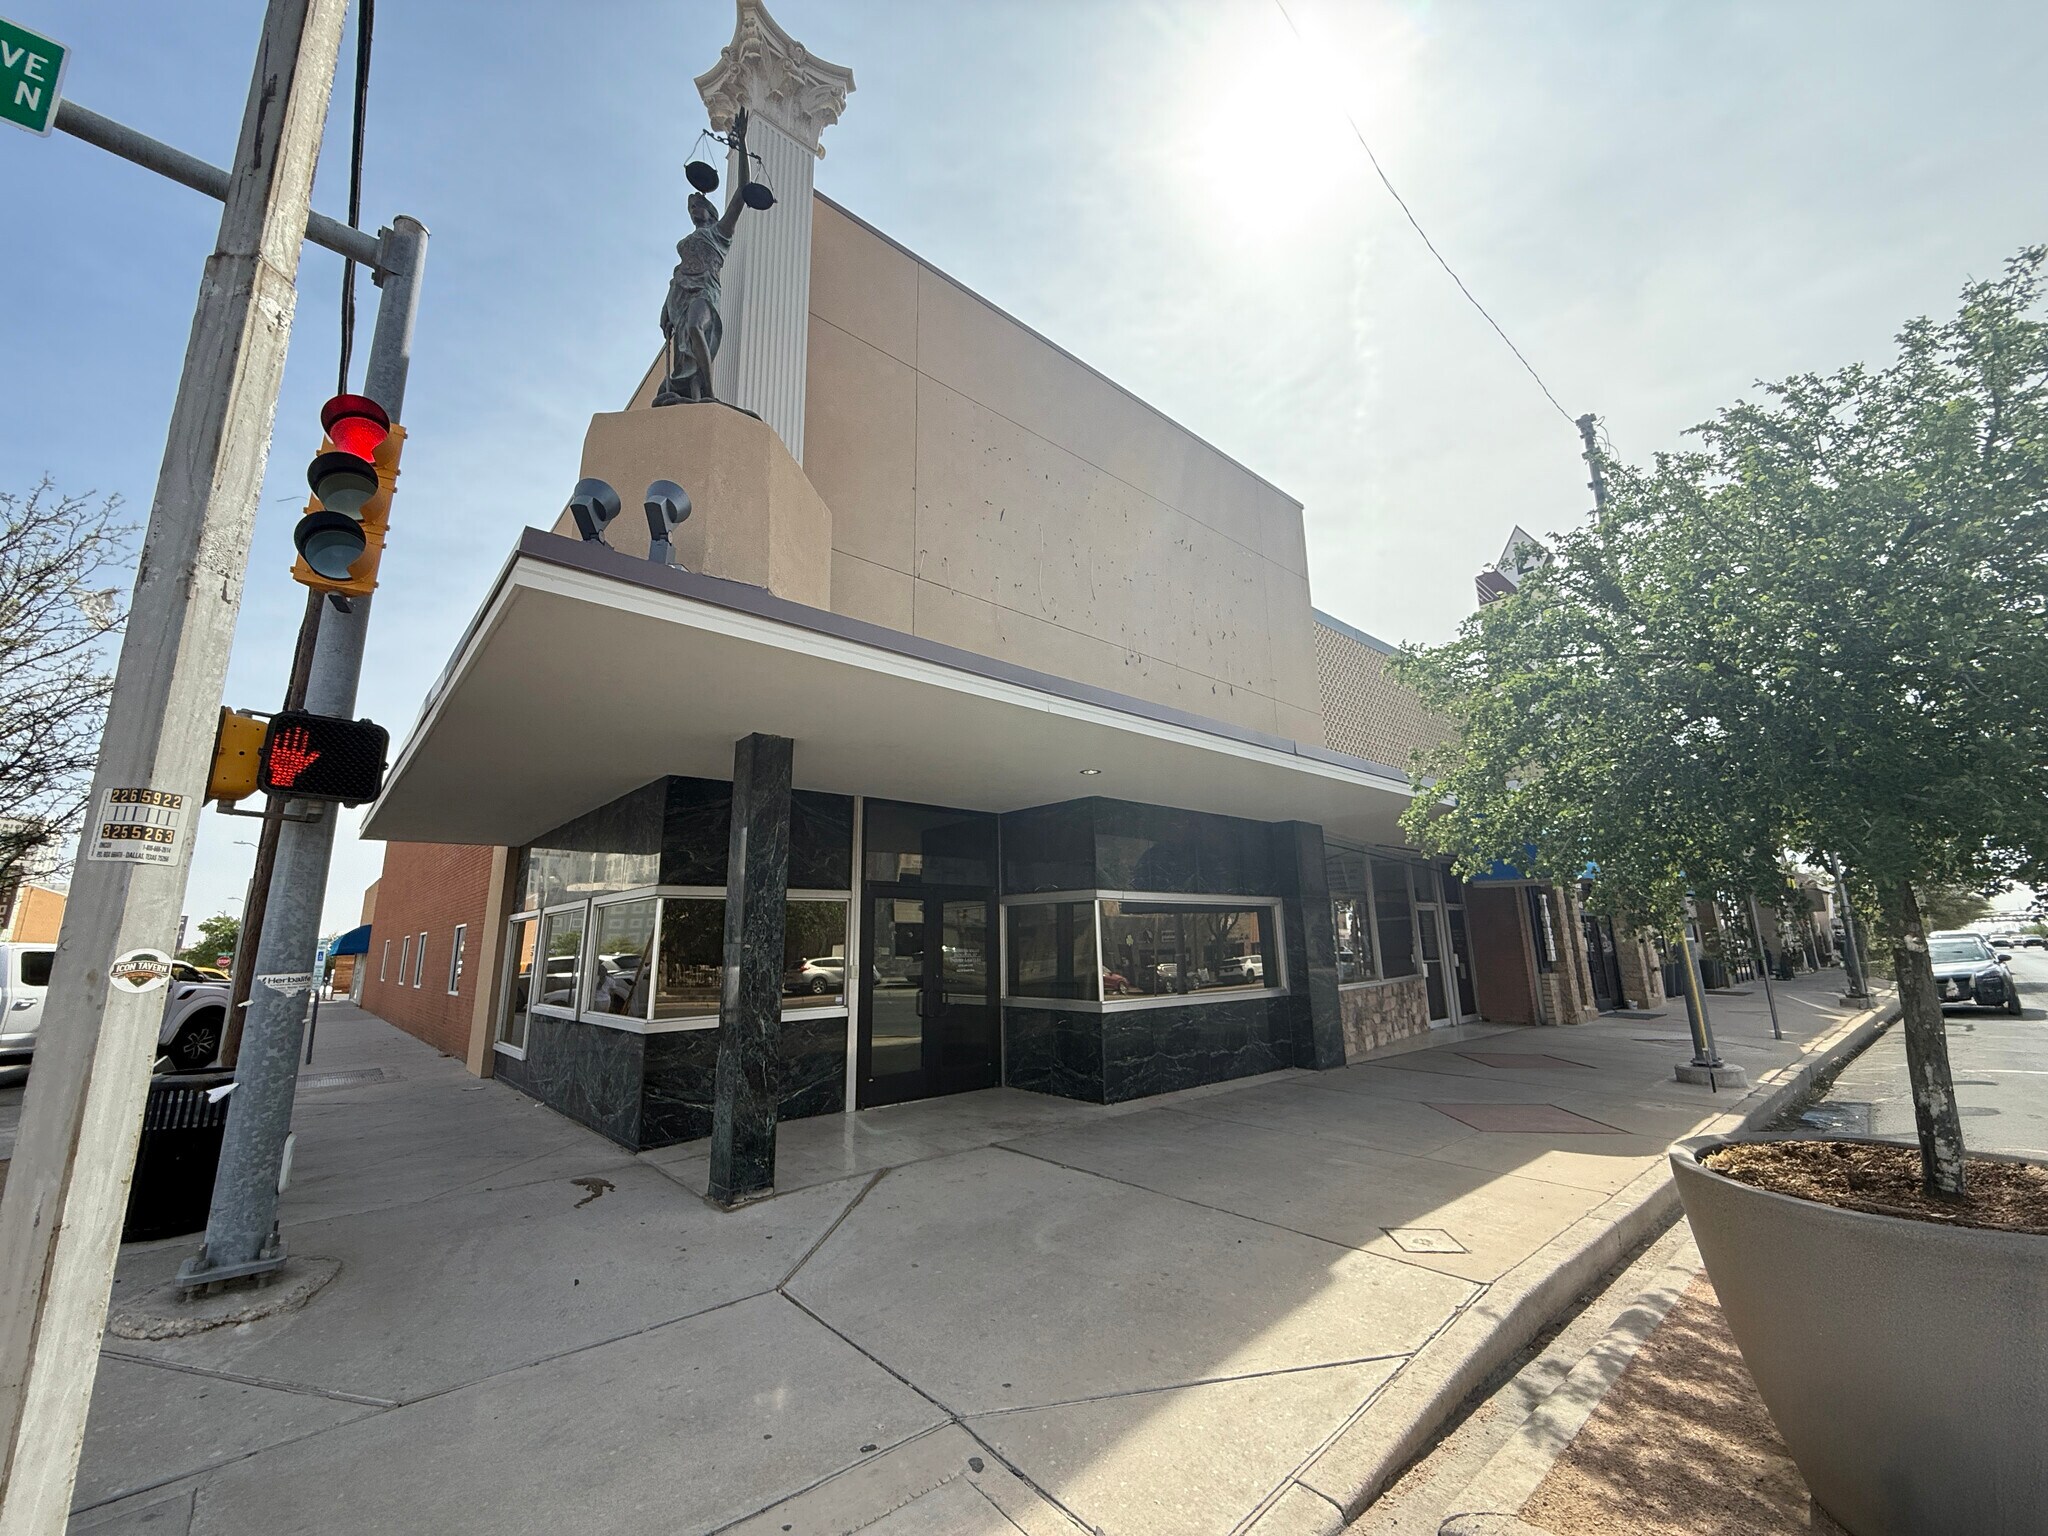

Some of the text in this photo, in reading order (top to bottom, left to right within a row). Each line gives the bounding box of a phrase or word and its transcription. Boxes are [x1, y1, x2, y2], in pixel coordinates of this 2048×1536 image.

[0, 39, 49, 81] VE
[14, 80, 41, 111] N
[111, 788, 181, 808] 2265922
[103, 824, 173, 843] 3255263
[116, 962, 168, 972] ICON TAVERN
[268, 975, 311, 984] Herbalife
